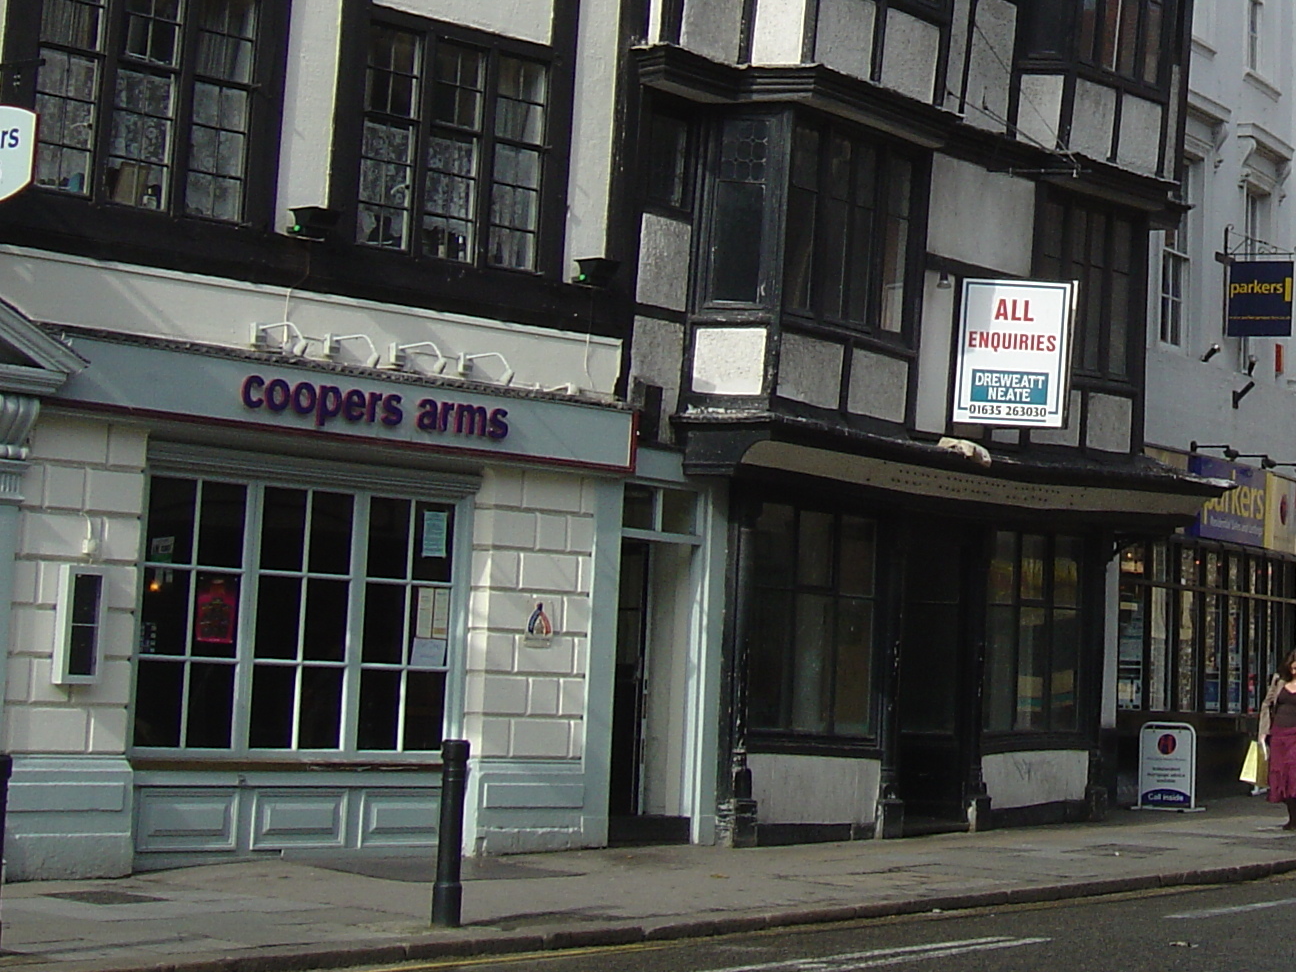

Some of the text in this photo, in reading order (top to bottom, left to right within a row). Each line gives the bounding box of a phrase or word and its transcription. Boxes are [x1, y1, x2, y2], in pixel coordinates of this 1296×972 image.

[1230, 279, 1284, 299] parkers
[994, 298, 1034, 322] ALL
[968, 331, 1057, 353] ENQUIRIES
[975, 372, 1046, 389] DREWEATT
[987, 386, 1031, 402] NEATE
[240, 374, 509, 440] coopers arms
[968, 404, 1047, 417] 01635 263030
[1147, 793, 1184, 802] Call inside
